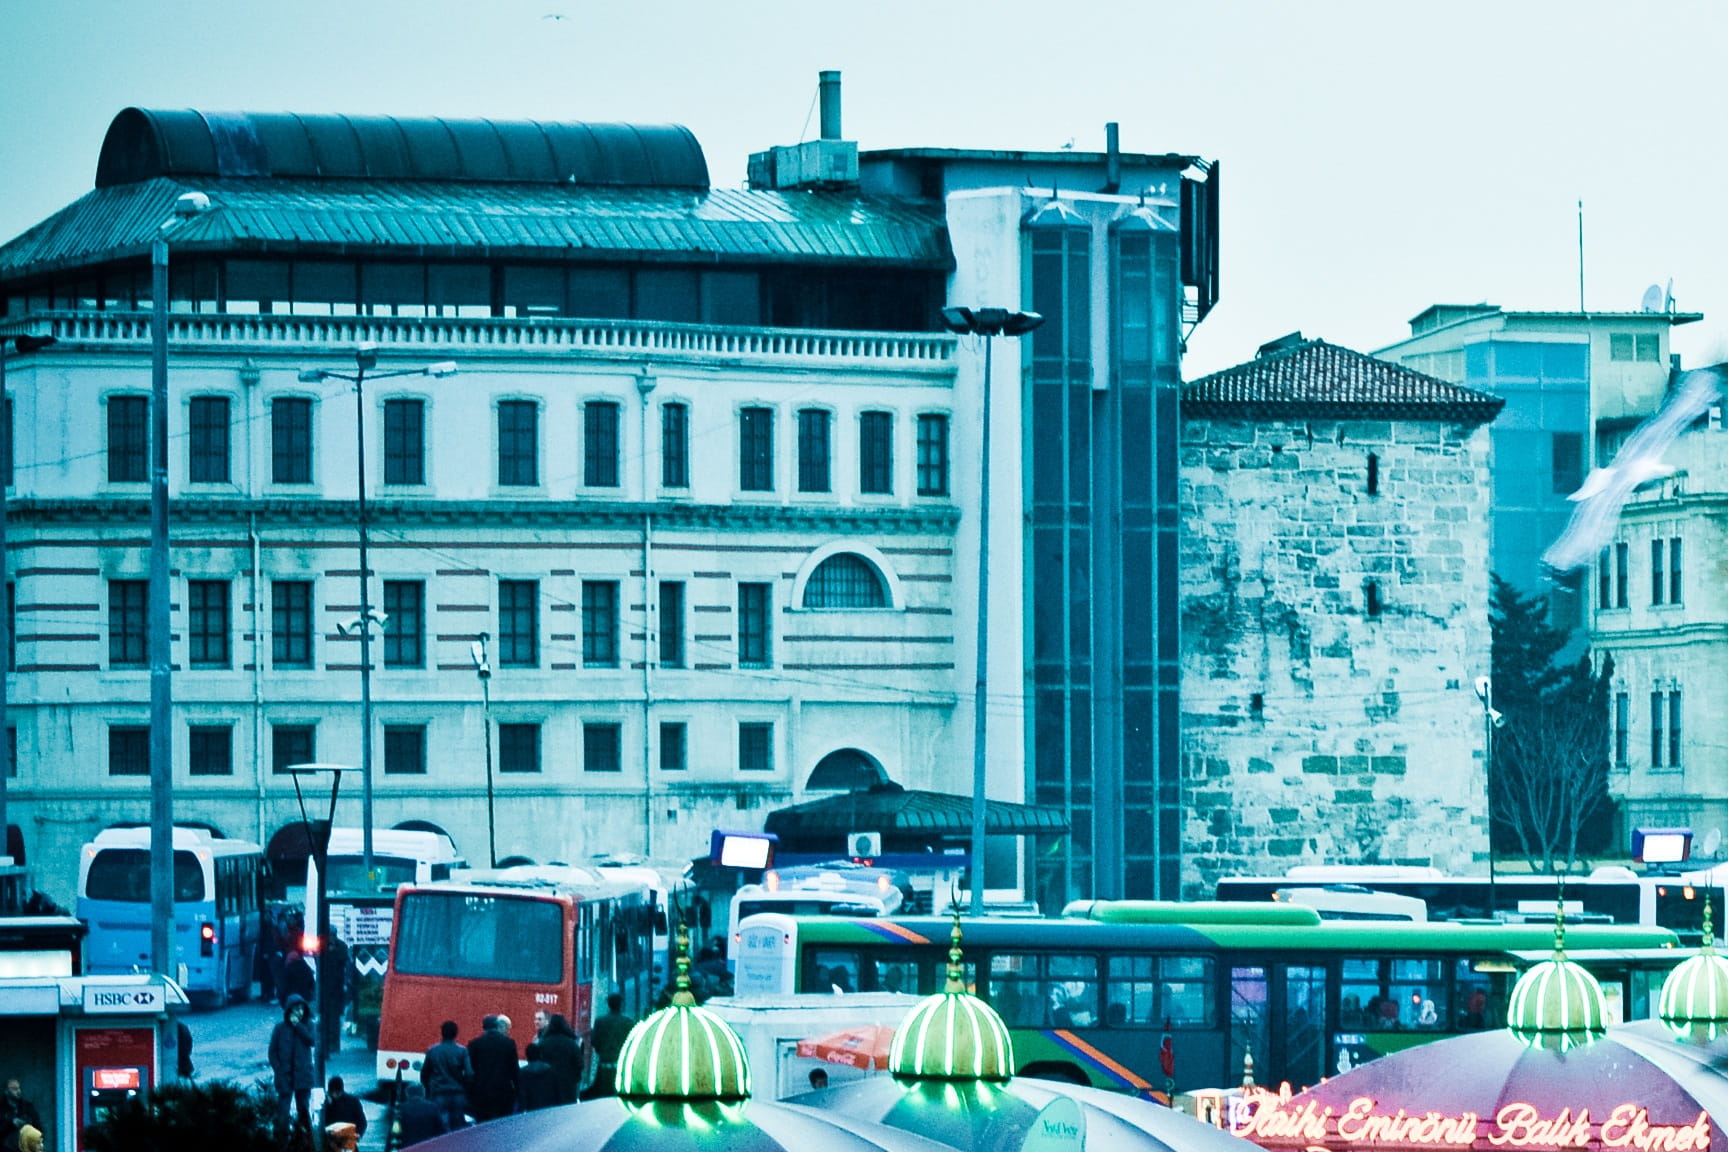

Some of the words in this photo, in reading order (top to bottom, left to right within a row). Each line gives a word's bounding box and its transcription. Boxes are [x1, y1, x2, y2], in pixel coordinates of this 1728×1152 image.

[94, 992, 132, 1006] HSBC
[1337, 1097, 1477, 1144] Eminönü
[1488, 1102, 1591, 1146] Balık
[1601, 1103, 1711, 1152] Ekmek
